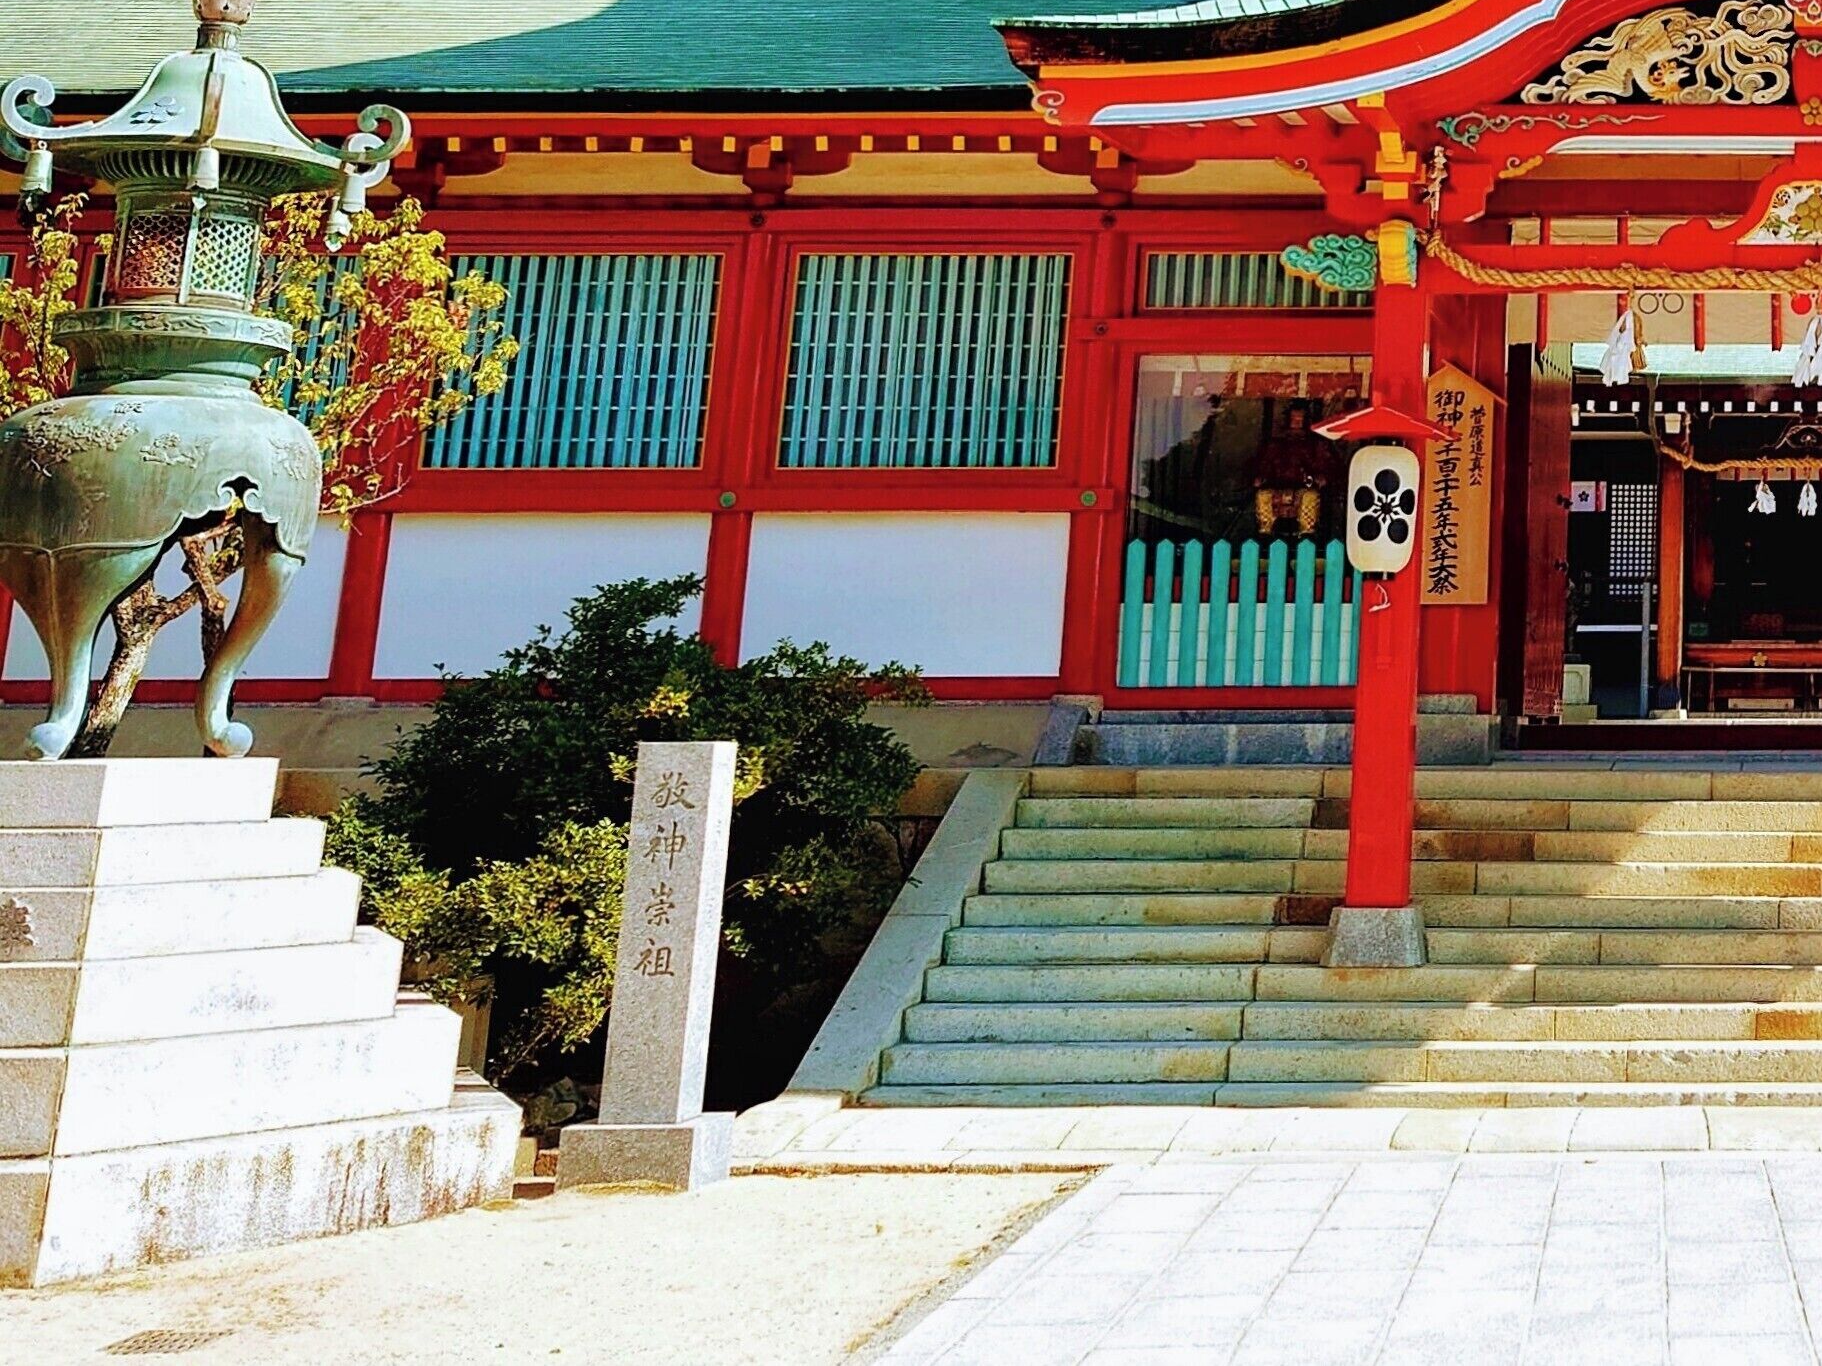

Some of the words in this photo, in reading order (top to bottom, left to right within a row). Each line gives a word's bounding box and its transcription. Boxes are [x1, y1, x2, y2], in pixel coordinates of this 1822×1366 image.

[1427, 389, 1466, 595] 御神千百二十五年式年大祭
[633, 771, 696, 977] 敬神崇祖
